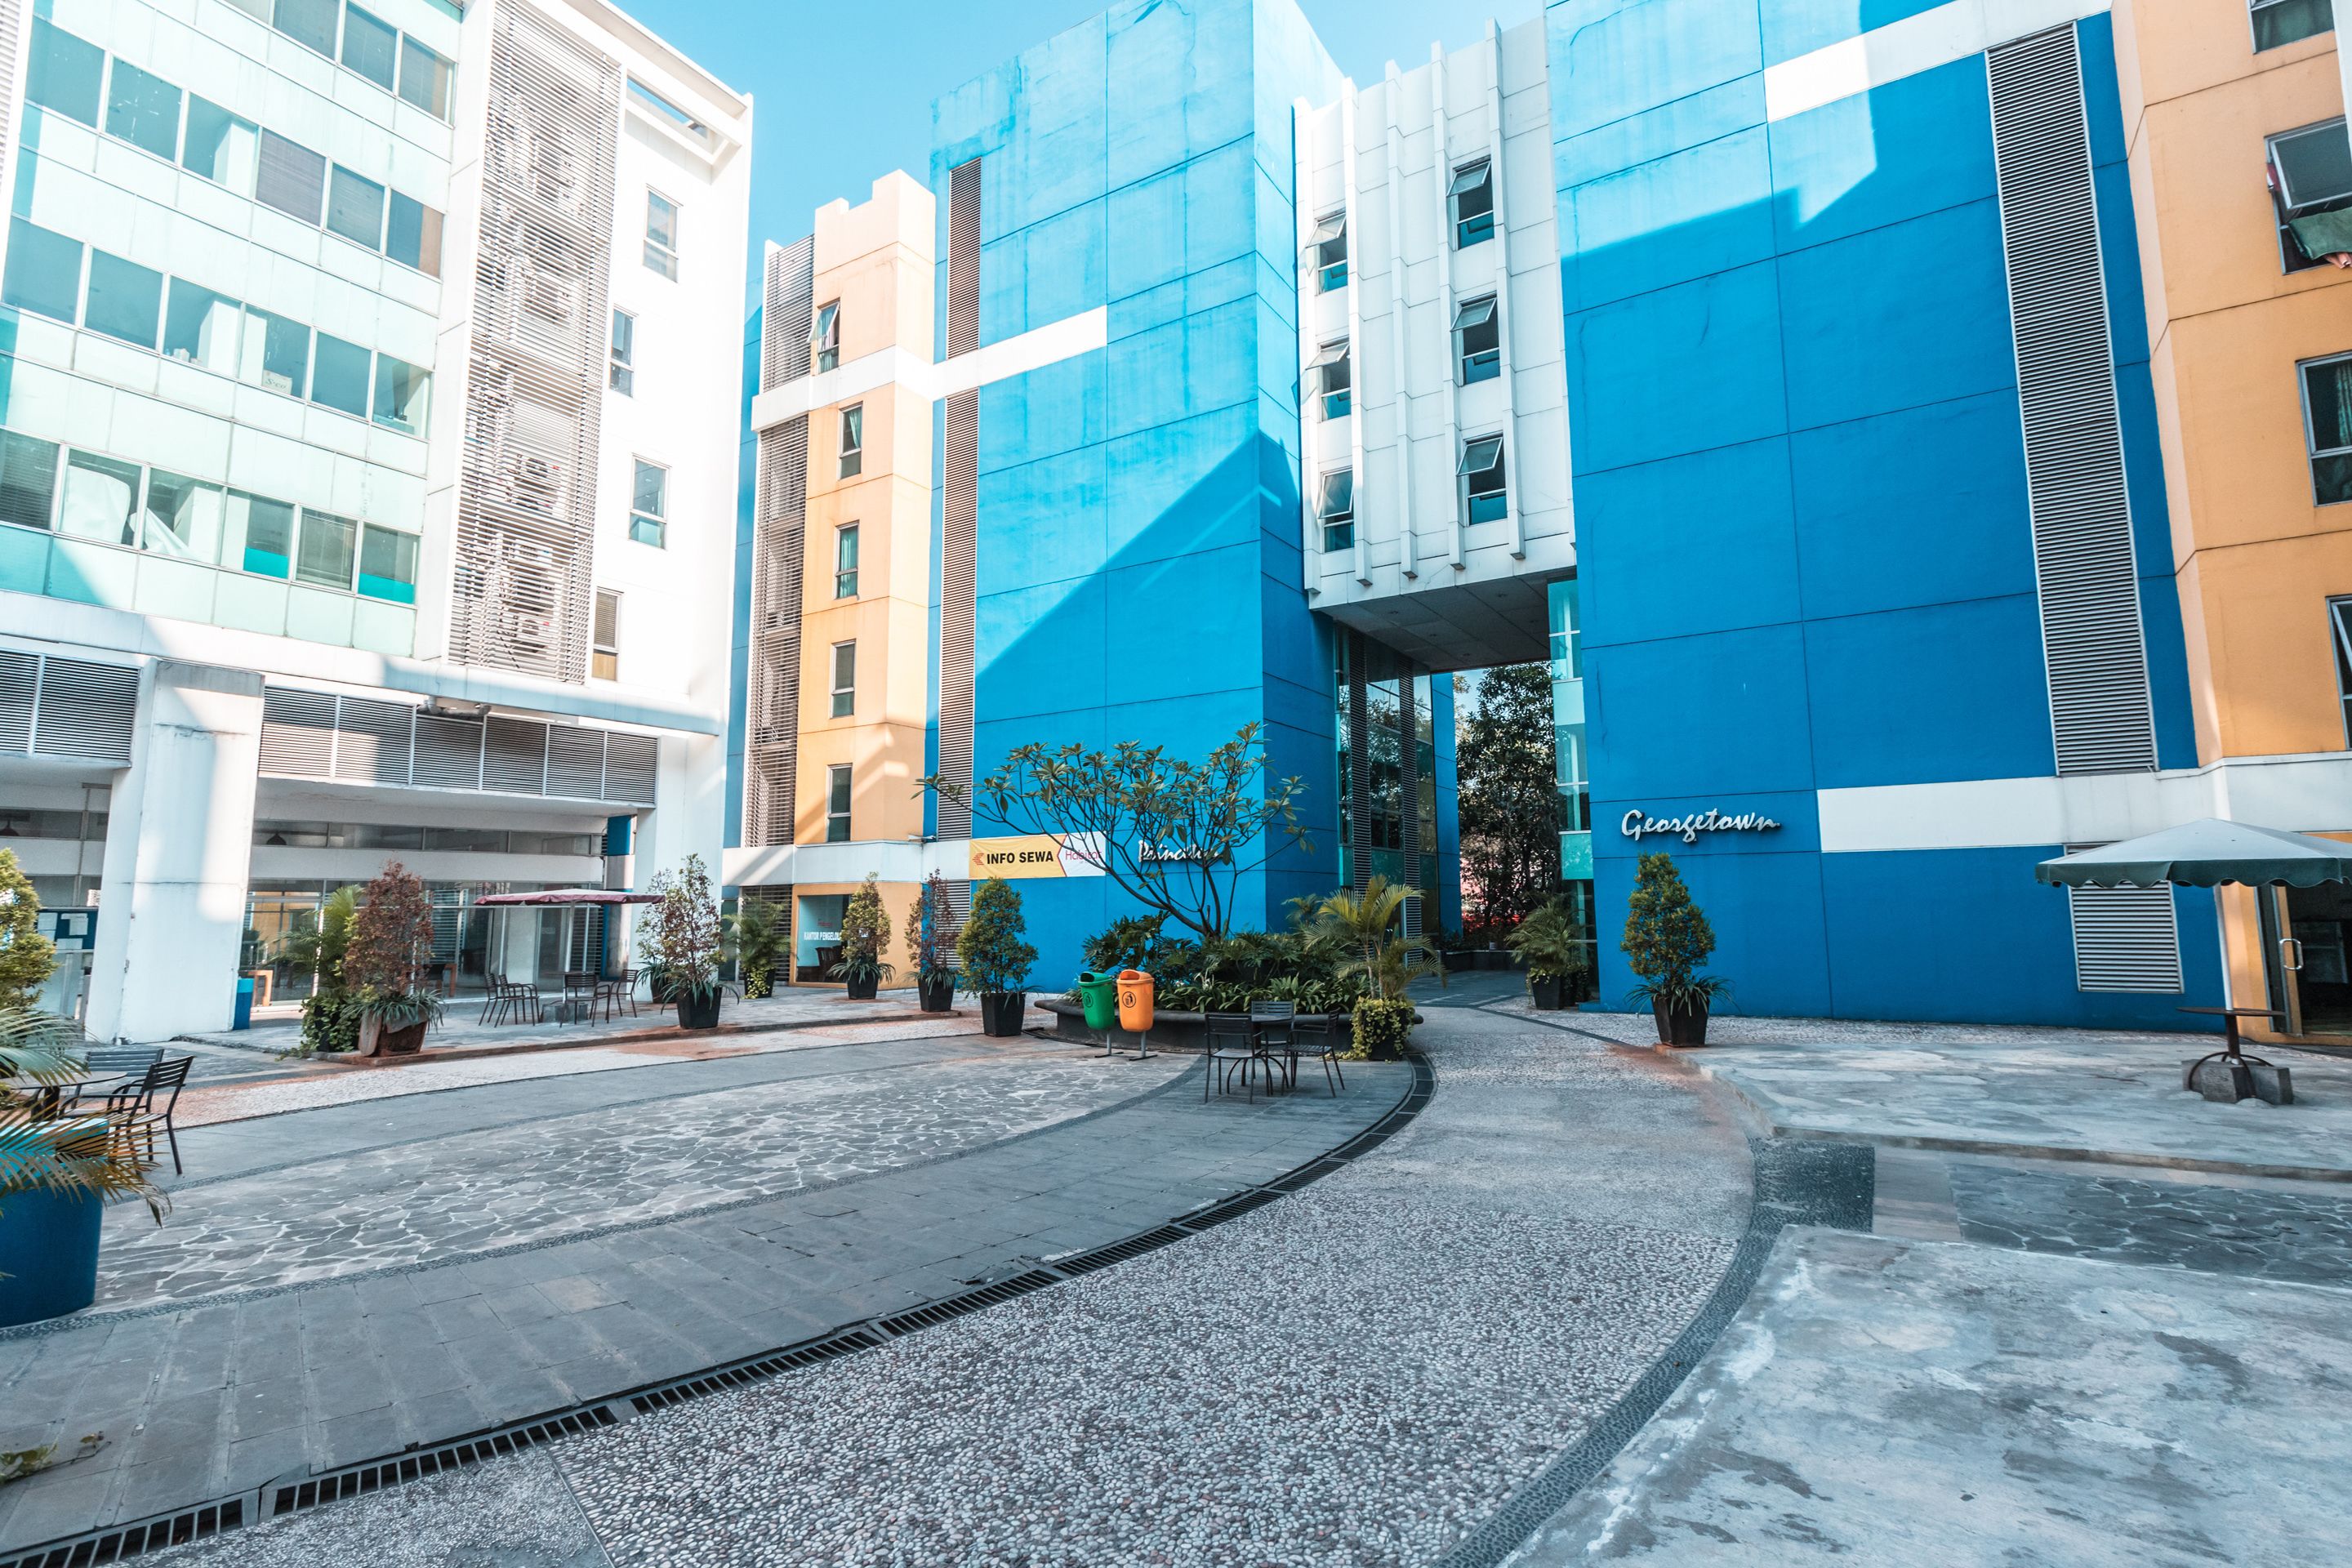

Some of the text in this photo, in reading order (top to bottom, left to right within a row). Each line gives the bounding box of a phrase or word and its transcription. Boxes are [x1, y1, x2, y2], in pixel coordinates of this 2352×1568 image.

[1621, 808, 1780, 843] Georgetown
[987, 851, 1054, 864] INFO SEWA
[804, 931, 841, 941] KANTOR PENGELOL
